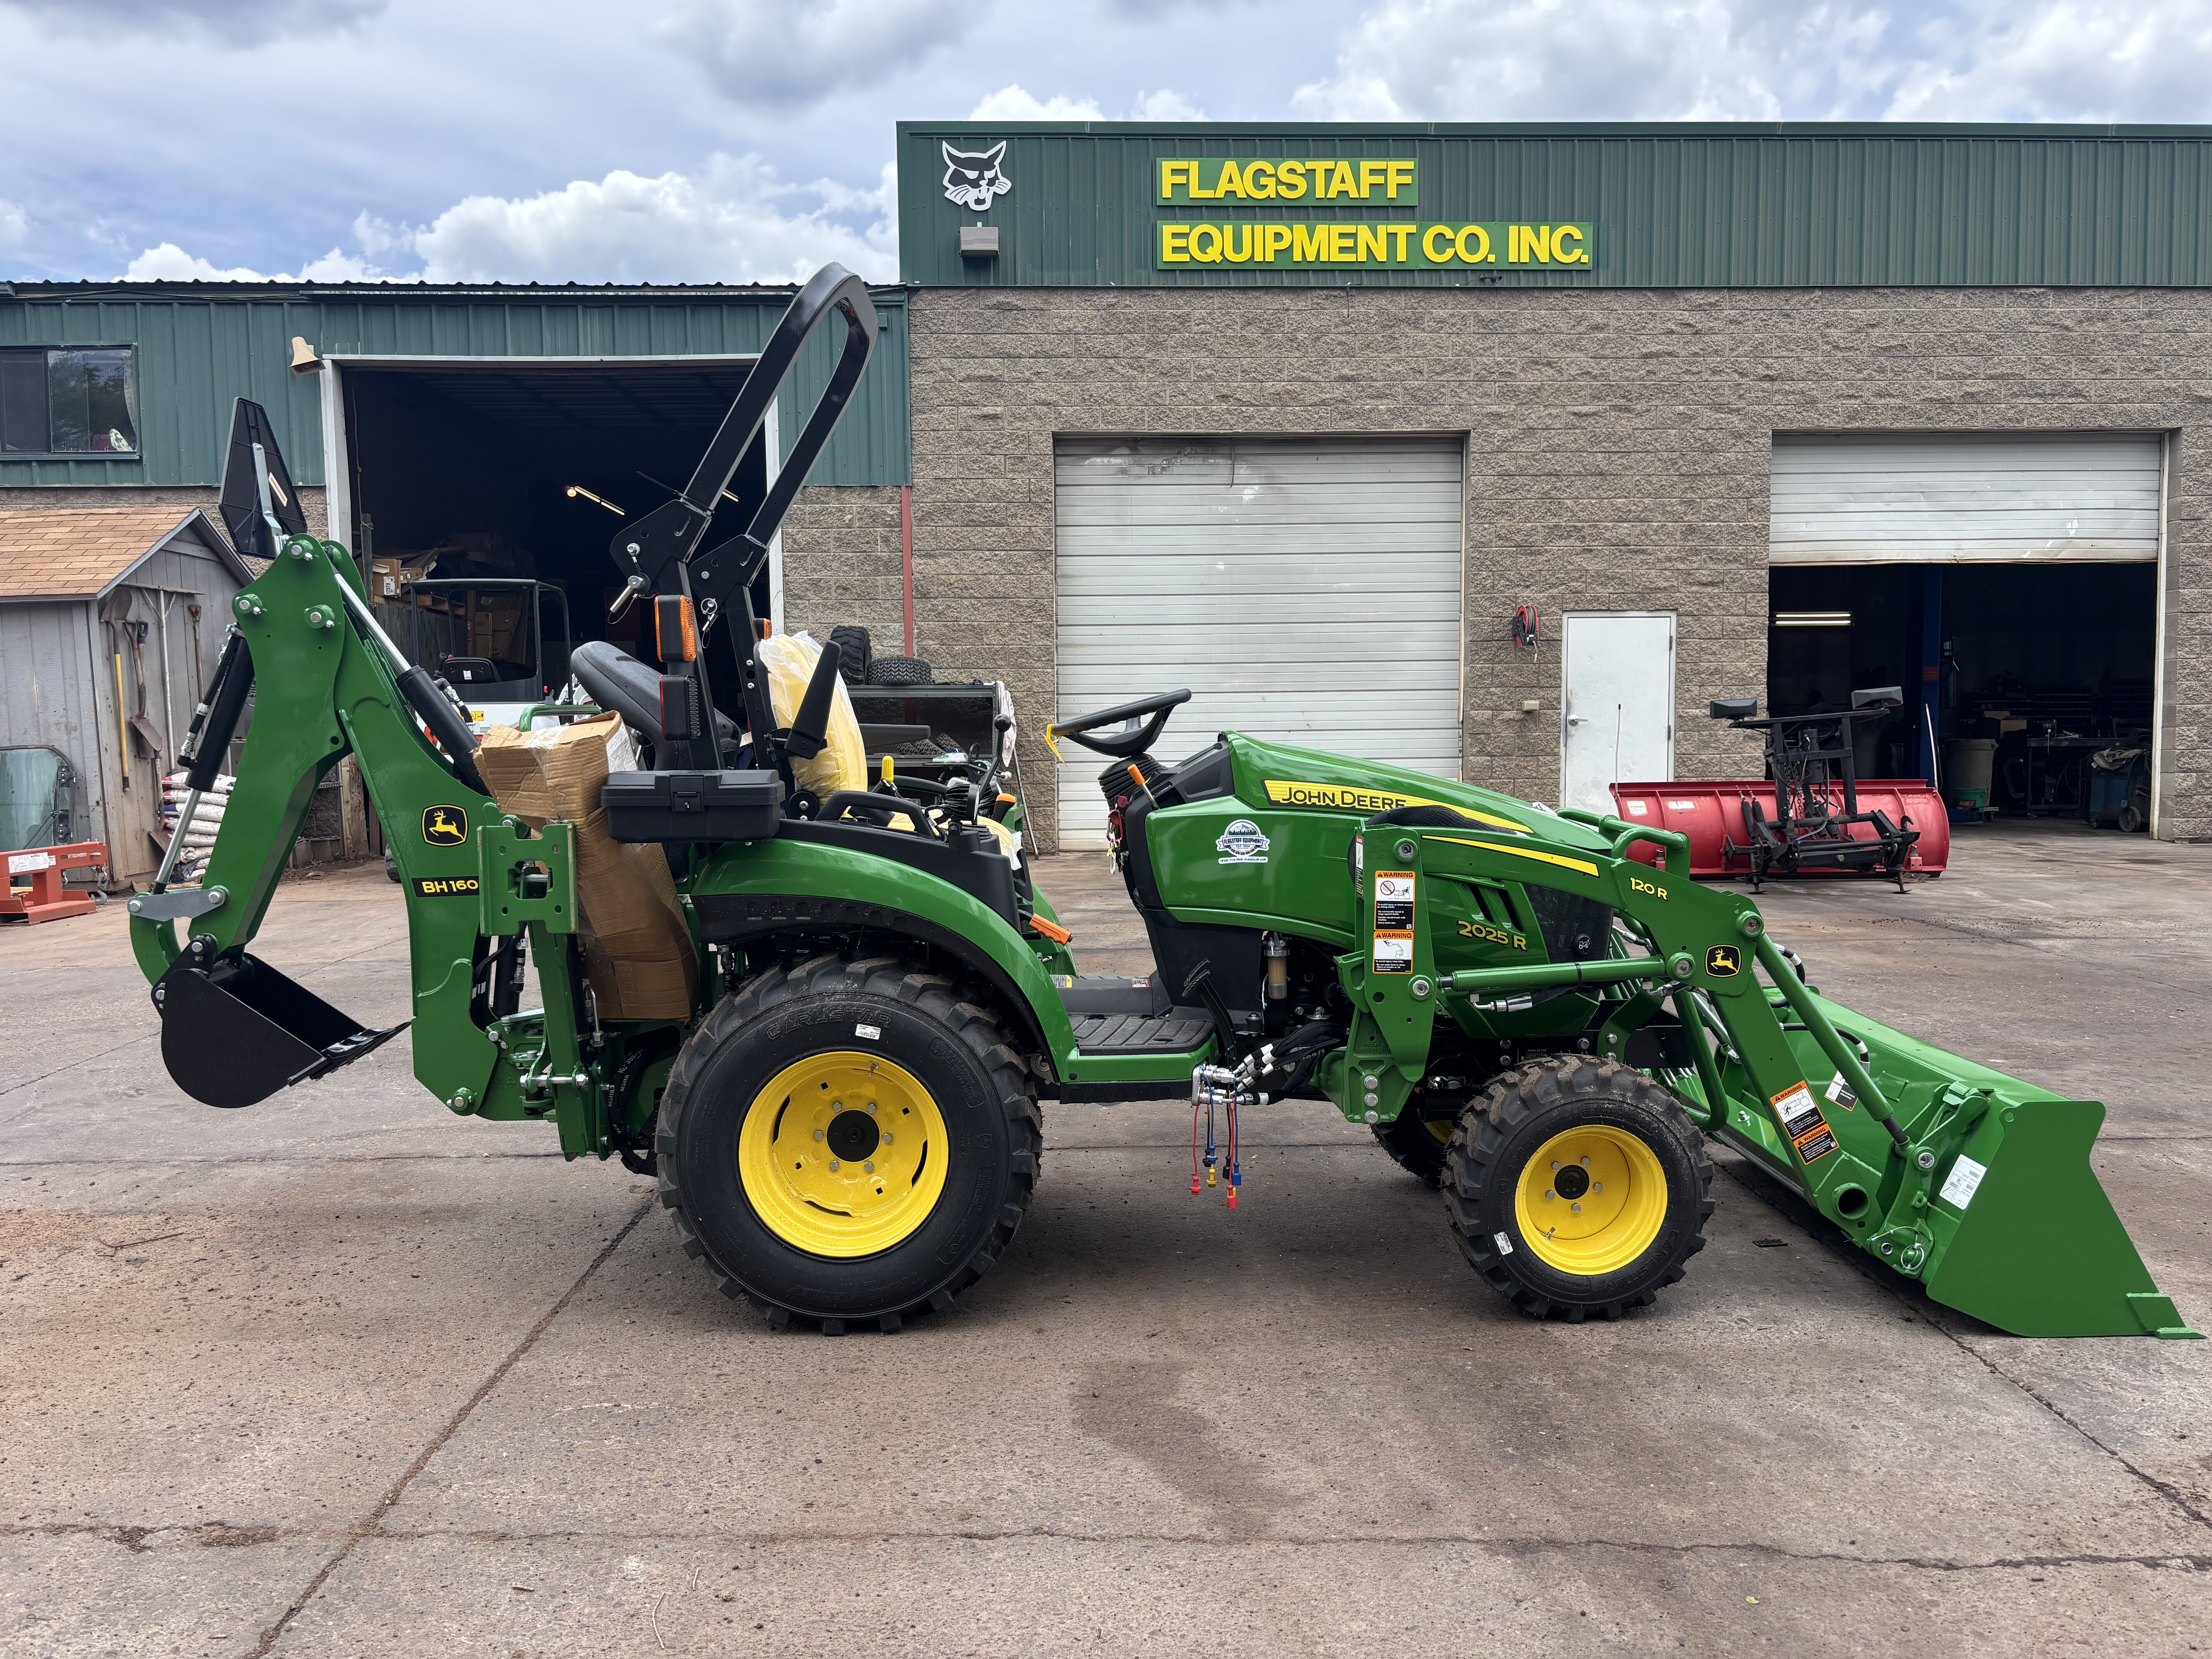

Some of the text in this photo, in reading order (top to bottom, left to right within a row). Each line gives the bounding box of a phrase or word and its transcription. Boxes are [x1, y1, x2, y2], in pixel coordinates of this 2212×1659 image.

[1162, 161, 1414, 199] FLAGSTAFF
[1163, 225, 1588, 263] EQUIPMENT CO. INC.
[1282, 787, 1335, 804] JOHN
[422, 880, 478, 893] BH 160
[1630, 877, 1668, 900] 120 R
[1458, 921, 1527, 951] 2025 R
[765, 1007, 891, 1040] CARLSTAR
[1780, 1085, 1802, 1098] WARNING
[1803, 1128, 1826, 1142] WARNING
[1605, 1230, 1679, 1293] CARLSTAR
